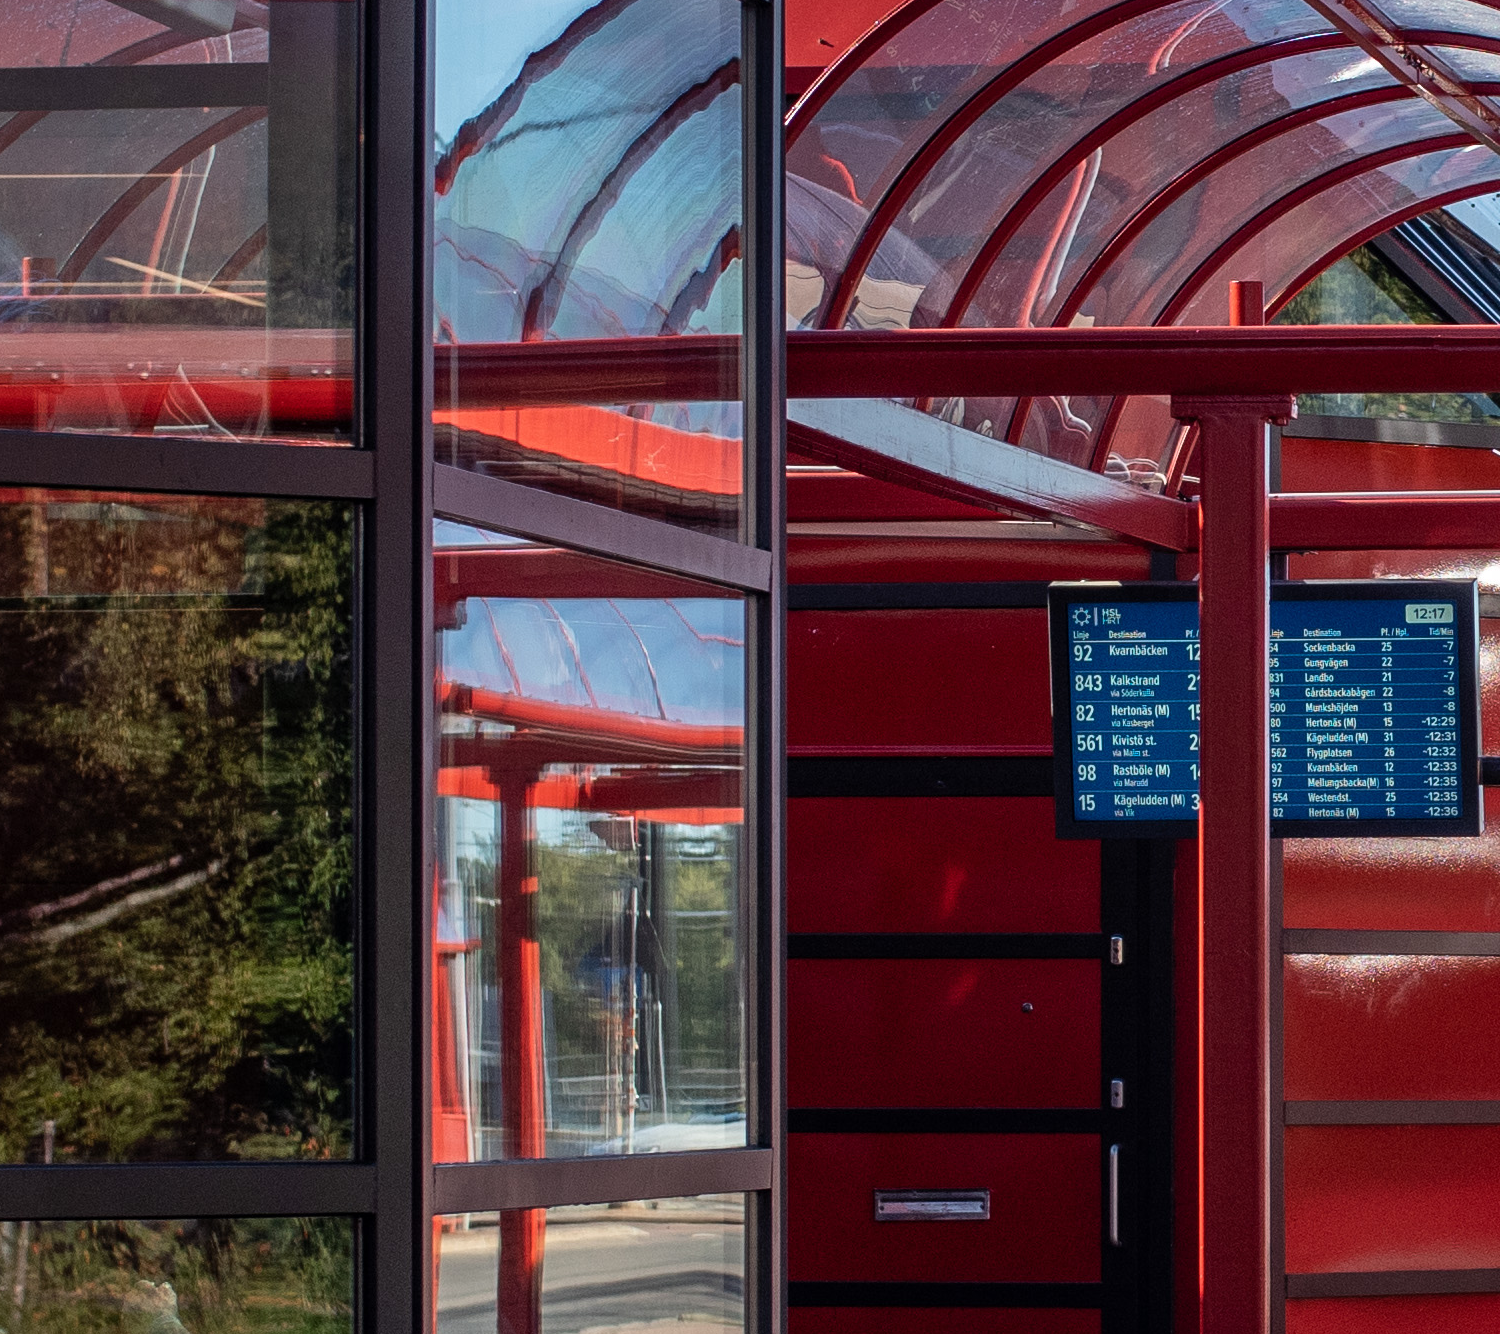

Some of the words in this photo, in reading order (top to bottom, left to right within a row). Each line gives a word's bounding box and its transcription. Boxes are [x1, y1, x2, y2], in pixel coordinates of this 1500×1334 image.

[1413, 608, 1446, 620] 12:17
[1073, 630, 1090, 640] Linje
[1108, 630, 1146, 638] Destination
[1269, 628, 1284, 638] inje
[1303, 628, 1342, 637] Destination
[1304, 642, 1356, 652] Sockenbacka
[1381, 642, 1392, 652] 25
[1073, 645, 1092, 662] 92
[1109, 645, 1168, 656] Kvarnbäcken
[1304, 657, 1348, 670] Gungvägen
[1382, 656, 1392, 666] 22
[1074, 674, 1102, 691] 843
[1110, 674, 1160, 686] Kalkstrand
[1269, 672, 1284, 682] 831
[1304, 672, 1334, 682] Landbo
[1382, 672, 1392, 682] 21
[1110, 689, 1120, 697] via
[1270, 688, 1280, 698] 94
[1305, 686, 1376, 699] Gårdsbackabågen
[1382, 687, 1393, 696] 22
[1076, 704, 1094, 722] 82
[1111, 704, 1152, 716] Hertonäs
[1154, 704, 1170, 718] (M)
[1270, 702, 1286, 712] 500
[1306, 702, 1358, 714] Munkshöjden
[1383, 702, 1392, 712] 13
[1112, 719, 1120, 727] via
[1122, 719, 1154, 728] Kasberget
[1270, 718, 1280, 728] 80
[1306, 718, 1342, 728] Hertonäs
[1344, 718, 1356, 729] (M)
[1383, 717, 1392, 726] 15
[1077, 734, 1102, 751] 561
[1112, 734, 1143, 746] Kivistö
[1145, 735, 1157, 746] st.
[1270, 733, 1280, 742] 15
[1306, 732, 1354, 744] Kägeludden
[1356, 733, 1368, 744] (M)
[1384, 732, 1394, 742] 31
[1271, 748, 1286, 758] 562
[1307, 748, 1352, 760] Flygplatsen
[1384, 747, 1395, 757] 26
[1078, 764, 1096, 781] 98
[1113, 764, 1153, 776] Rastböle
[1155, 764, 1170, 778] (M)
[1272, 762, 1282, 772] 92
[1308, 762, 1358, 772] Kvarnbäcken
[1384, 762, 1394, 772] 12
[1272, 778, 1282, 788] 97
[1385, 777, 1394, 786] 16
[1078, 794, 1096, 811] 15
[1114, 794, 1168, 808] Kägeludden
[1170, 794, 1186, 807] (M)
[1272, 792, 1288, 802] 554
[1308, 792, 1352, 802] Westendst.
[1386, 792, 1396, 802] 25
[1114, 809, 1124, 817] via
[1272, 807, 1284, 818] 82
[1308, 807, 1344, 817] Hertonäs
[1346, 808, 1360, 818] (M)
[1386, 807, 1396, 816] 15
